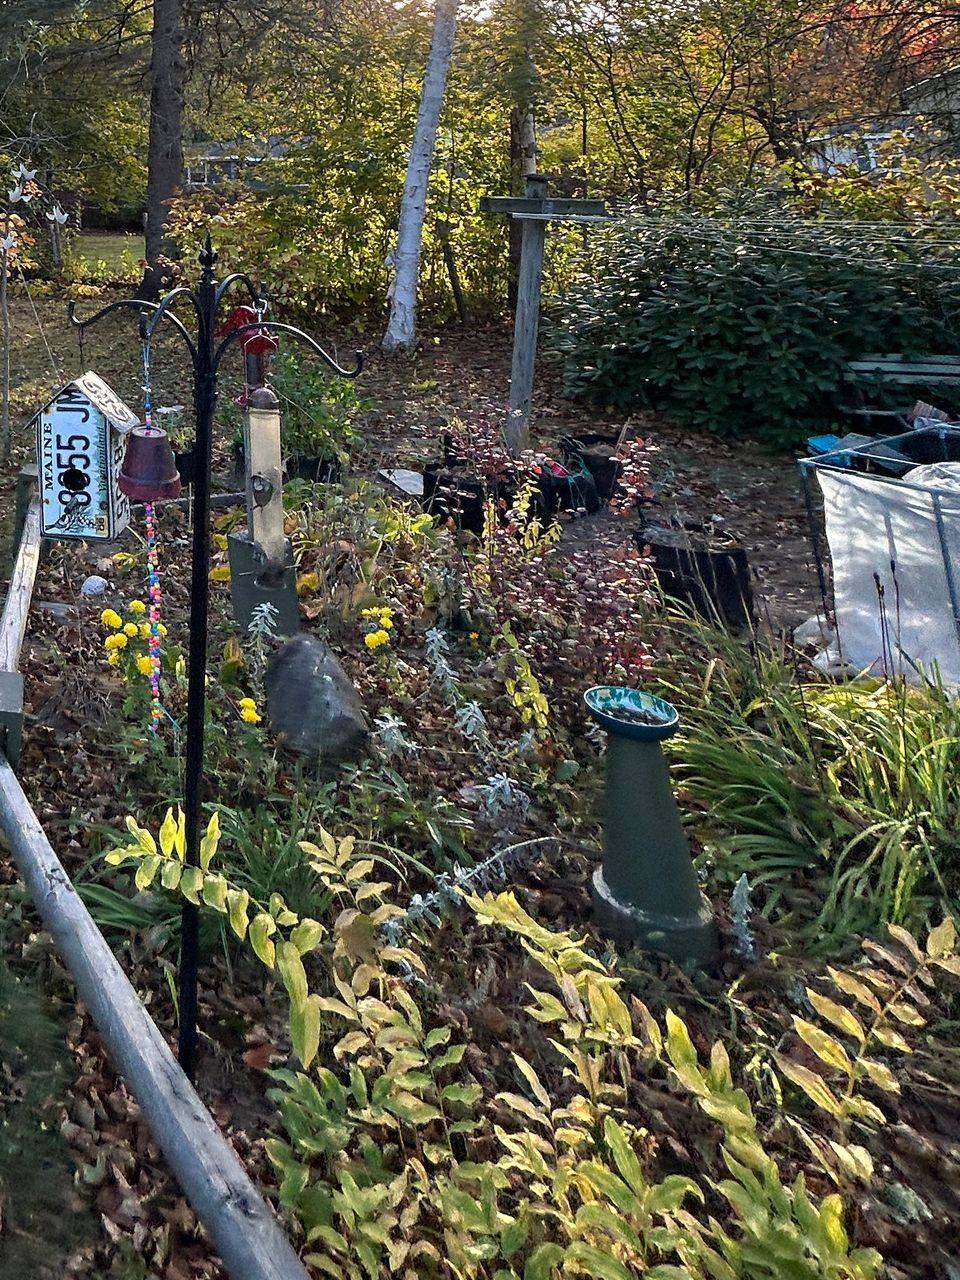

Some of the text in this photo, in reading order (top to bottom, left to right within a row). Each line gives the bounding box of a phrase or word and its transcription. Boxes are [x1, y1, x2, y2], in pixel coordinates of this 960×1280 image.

[44, 422, 54, 491] MAINE
[56, 434, 91, 507] 855
[98, 427, 107, 494] Vacationland
